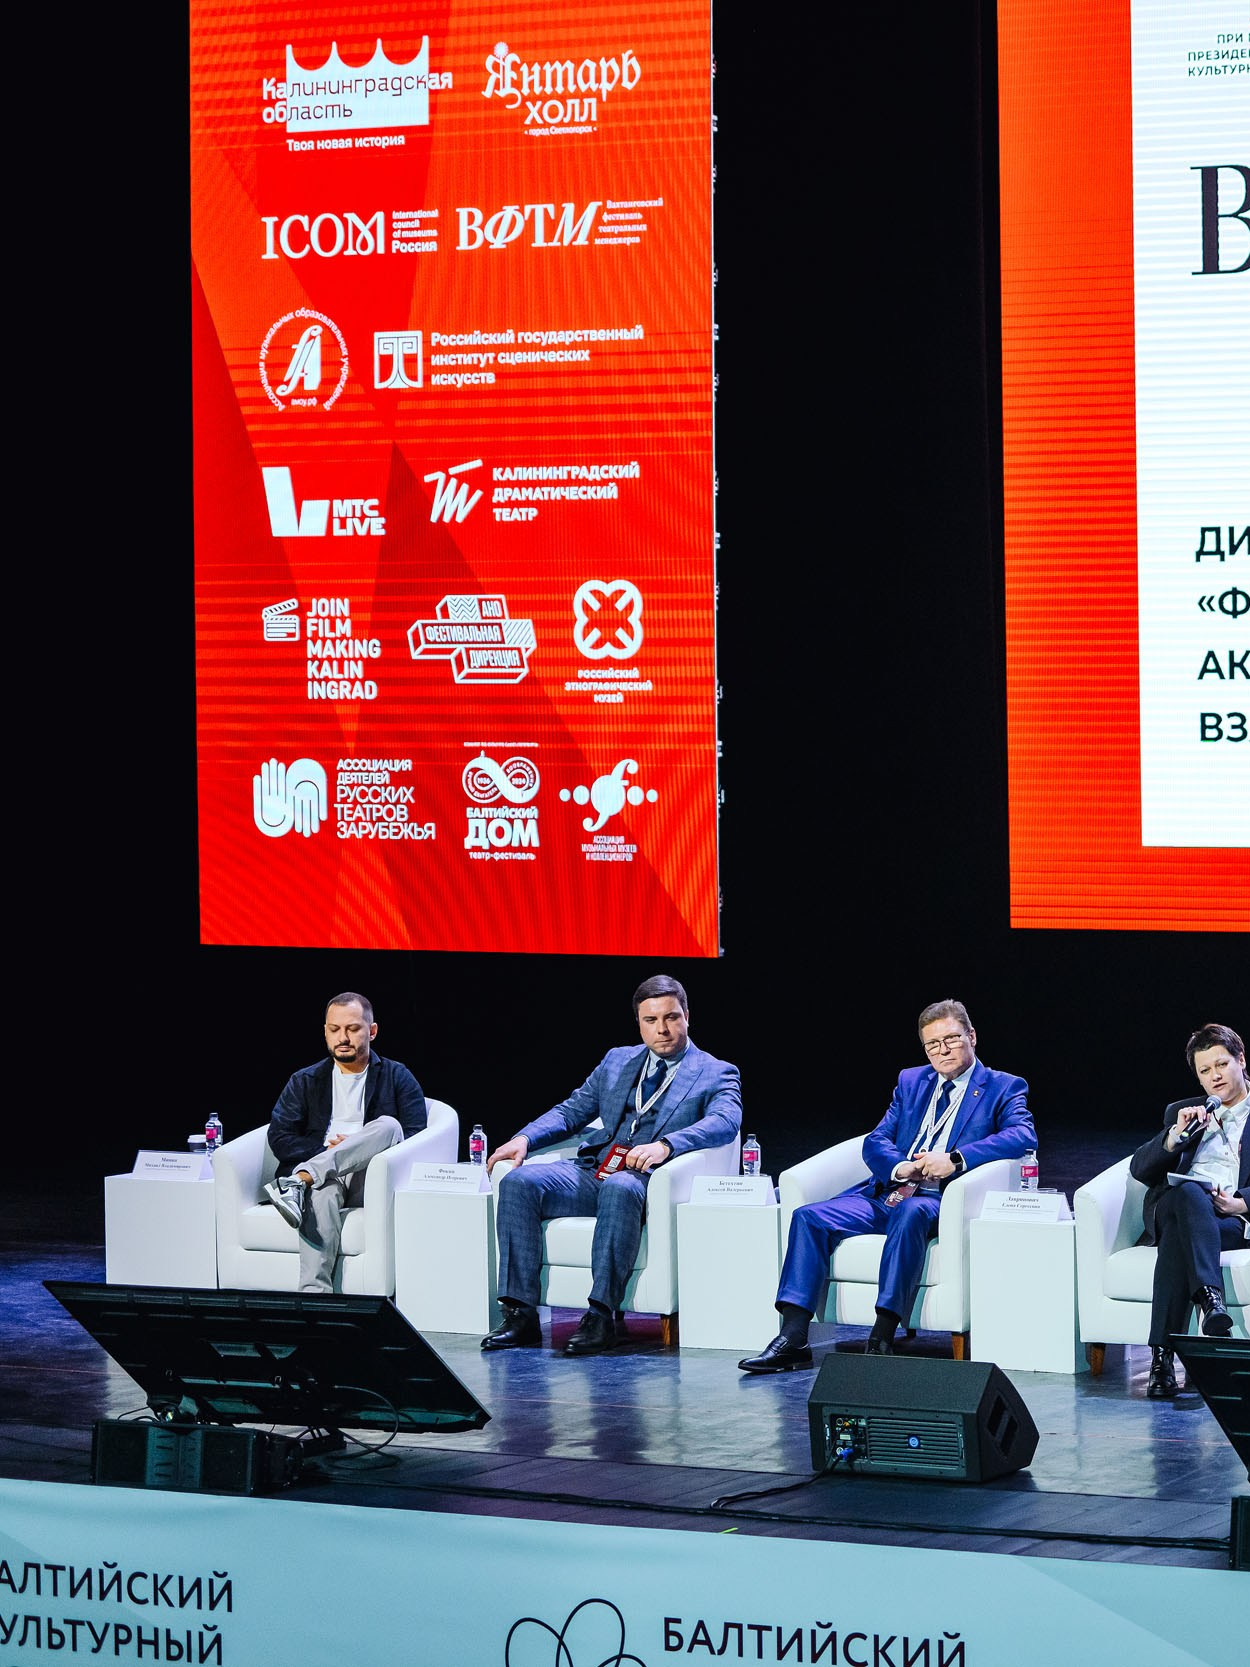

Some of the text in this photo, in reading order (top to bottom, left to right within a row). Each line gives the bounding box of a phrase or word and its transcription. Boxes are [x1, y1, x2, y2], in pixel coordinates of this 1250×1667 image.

[1217, 33, 1243, 44] ПРИ
[262, 72, 453, 100] Калининградская
[262, 101, 353, 123] область
[523, 97, 598, 125] ХОЛЛ
[286, 135, 406, 152] Твоя новая история
[455, 201, 602, 250] ВФТМ
[261, 211, 385, 260] ICOM
[392, 240, 438, 253] Россия
[431, 325, 644, 346] Российский государственный
[431, 349, 590, 367] институт сценических
[431, 372, 496, 388] искусств
[492, 461, 641, 481] КАЛИНИНГРАДСКИЙ
[491, 482, 618, 503] ДРАМАТИЧЕСКИЙ
[332, 498, 380, 518] МТС
[492, 507, 539, 522] ТЕАТР
[332, 517, 386, 537] LIVE
[306, 597, 350, 617] JOIN
[481, 600, 503, 618] АНО
[306, 618, 352, 638] FILM
[425, 625, 502, 643] ФЕСТИВАЛЬНАЯ
[307, 638, 382, 659] MAKING
[469, 649, 521, 669] ДИРЕКЦИЯ
[307, 660, 364, 679] KALIN
[577, 667, 640, 679] РОССИЙСКИЙ
[307, 680, 378, 700] INGRAD
[564, 679, 653, 691] ЭТНОГРАФИЧЕСКИЙ
[593, 692, 624, 703] МУЗЕЙ
[336, 758, 413, 772] АССОЦИАЦИЯ
[336, 770, 390, 785] ДЕЯТЕЛЕЙ
[336, 785, 416, 803] РУССКИХ
[333, 803, 409, 822] ТЕАТРОВ
[466, 805, 539, 819] БАЛТИЙСКИЙ
[336, 821, 436, 840] ЗАРУБЕЖЬЯ
[464, 818, 540, 850] ДОМ
[663, 1616, 966, 1667] БАЛТИЙСКИЙ
